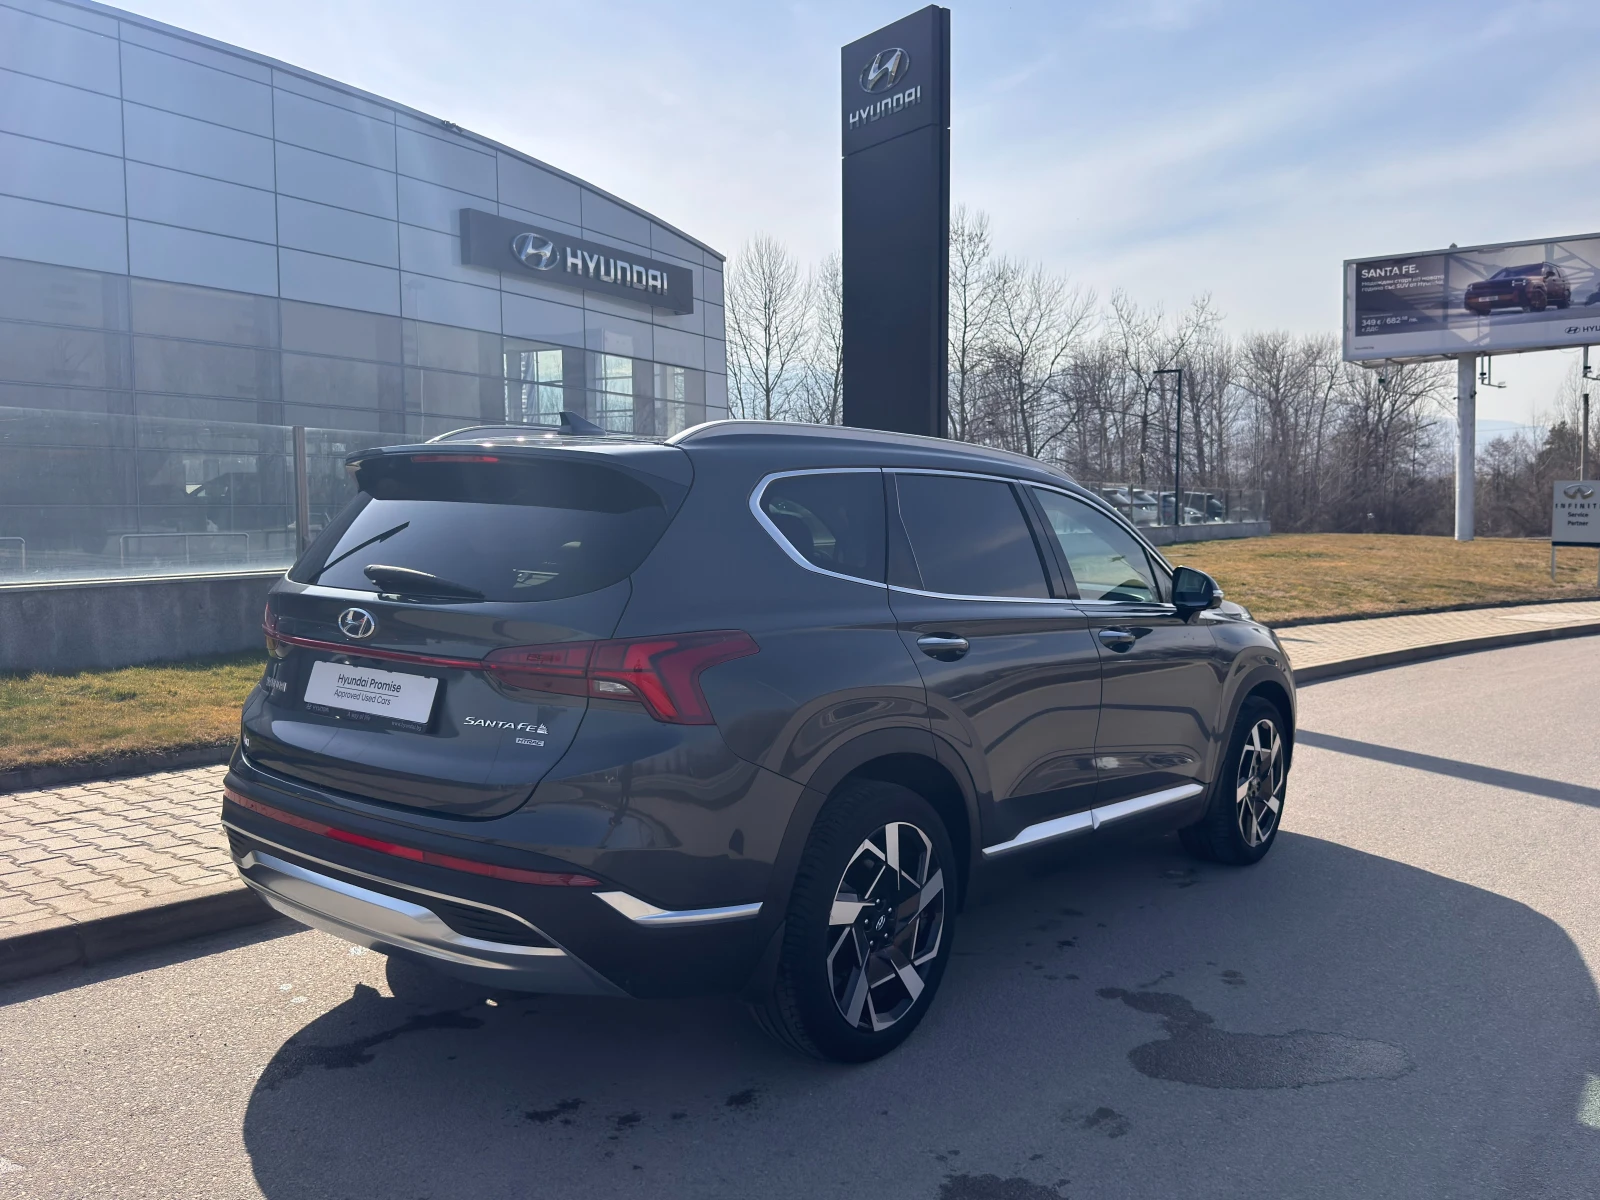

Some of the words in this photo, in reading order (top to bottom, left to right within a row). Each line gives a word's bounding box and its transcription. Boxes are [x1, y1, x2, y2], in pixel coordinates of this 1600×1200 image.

[849, 85, 921, 130] HYUNDAI
[566, 246, 669, 296] HYUNDAI
[1361, 266, 1400, 279] SANTA
[1402, 264, 1419, 275] FE.
[1361, 318, 1376, 327] 349
[337, 673, 370, 688] Hyundai
[369, 678, 402, 693] Promise
[333, 688, 361, 701] Approved
[361, 692, 377, 704] Used
[376, 695, 391, 706] Cars
[463, 716, 515, 729] SANTA
[516, 722, 538, 733] FE
